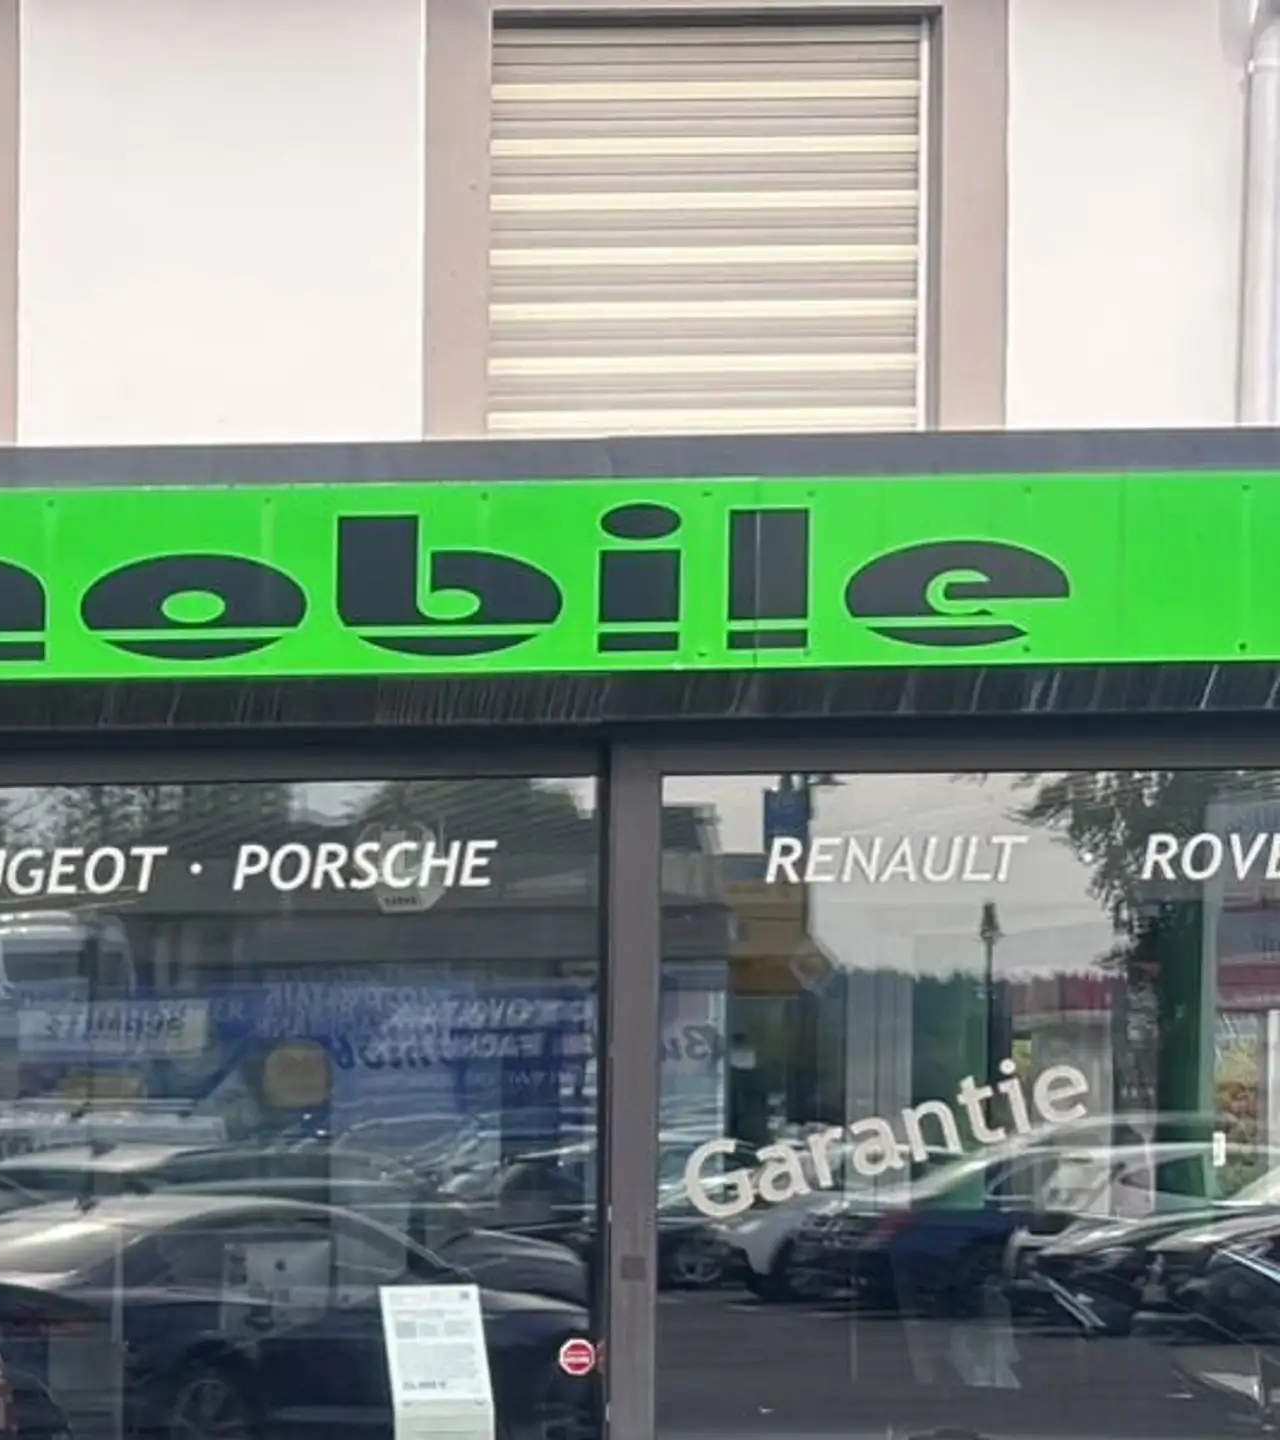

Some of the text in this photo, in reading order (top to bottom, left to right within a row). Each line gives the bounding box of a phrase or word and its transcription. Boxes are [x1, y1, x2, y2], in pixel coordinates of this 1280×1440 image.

[232, 839, 498, 892] PORSCHE
[764, 833, 1030, 885] RENAULT
[683, 1057, 1091, 1219] Garantie
